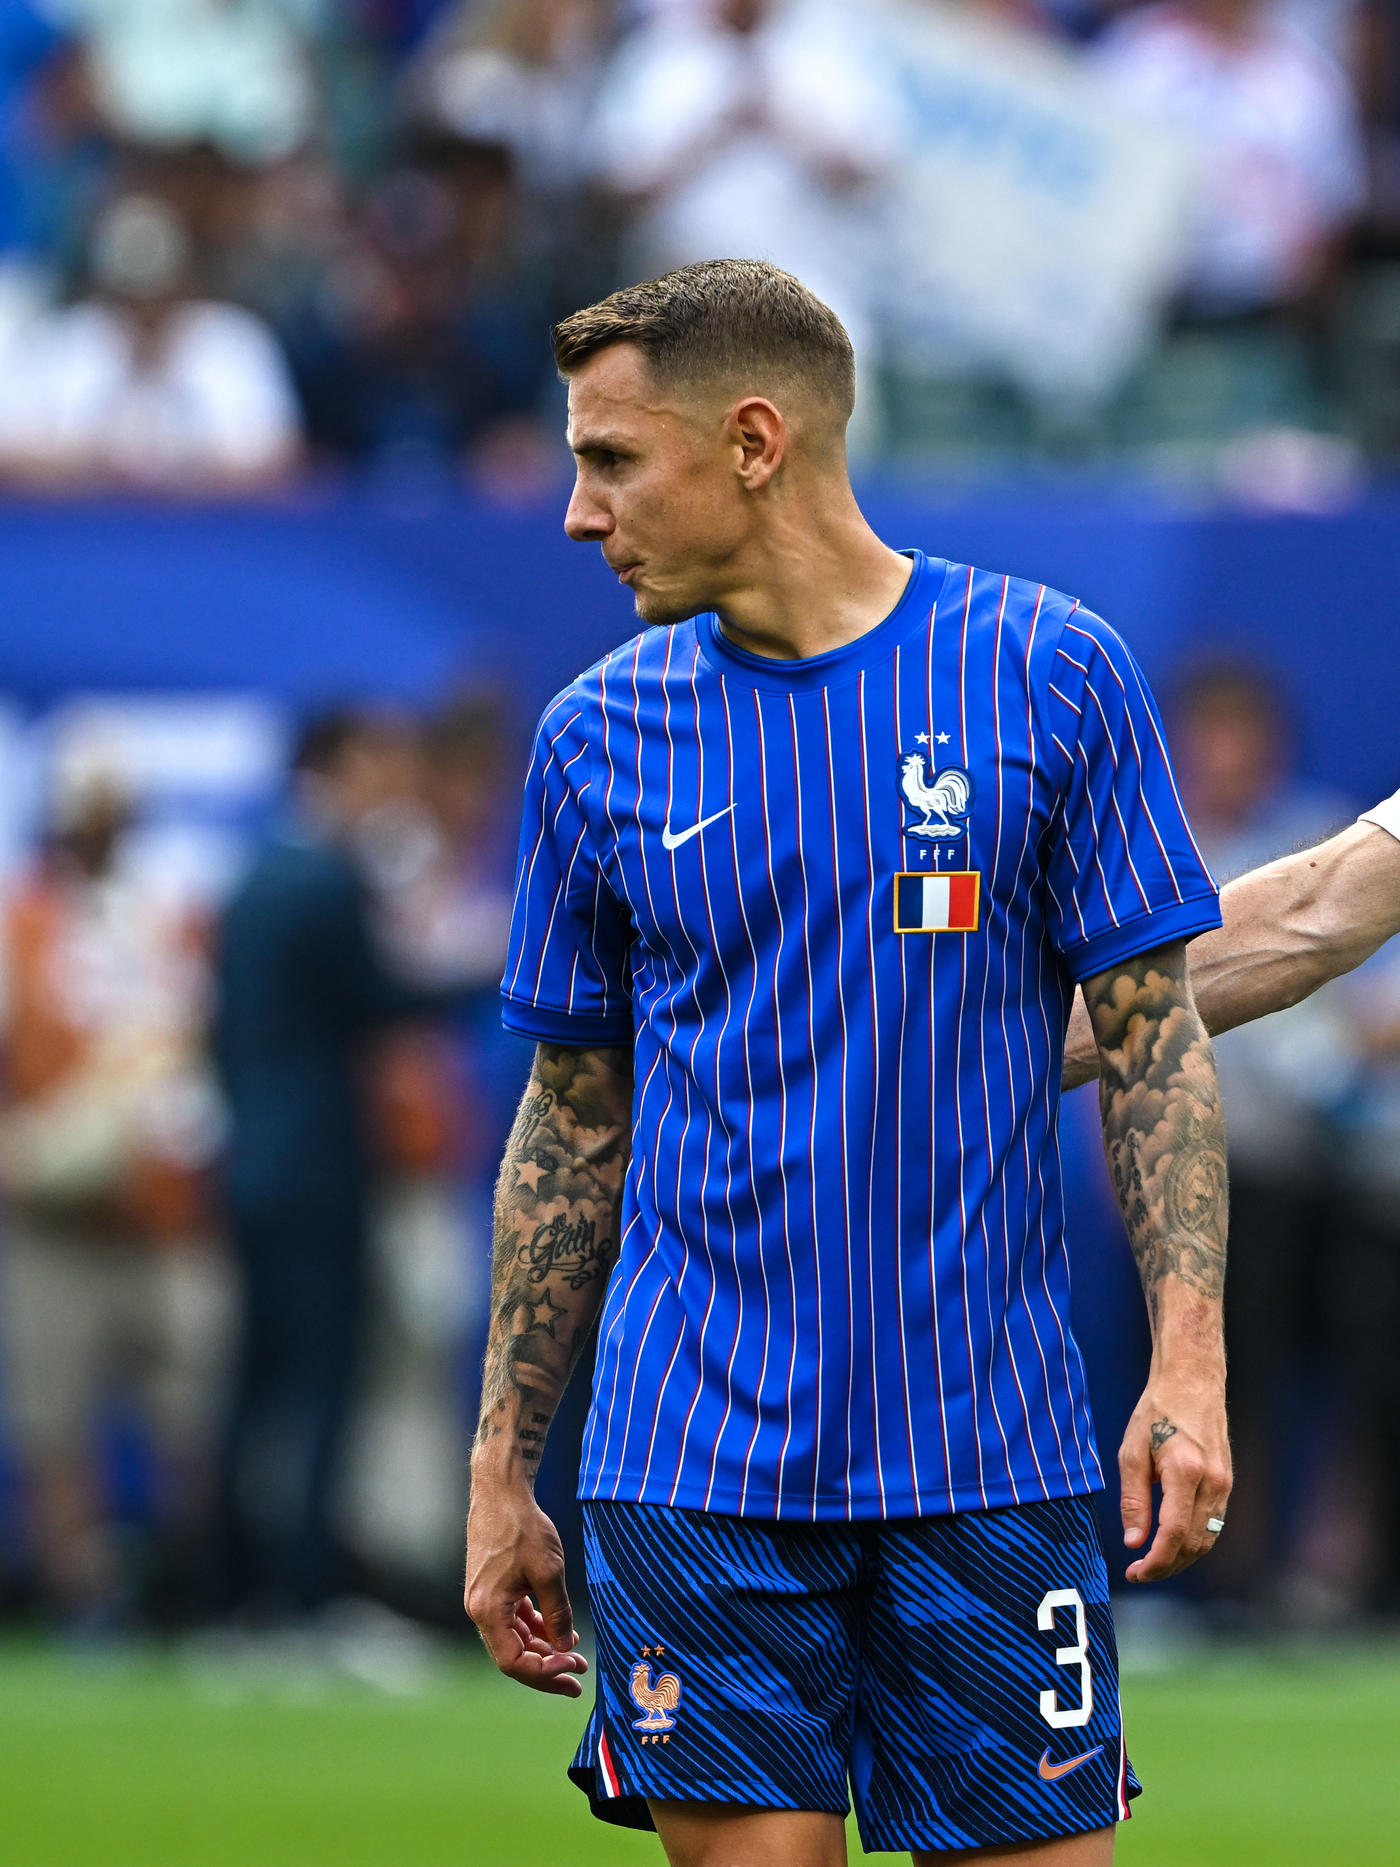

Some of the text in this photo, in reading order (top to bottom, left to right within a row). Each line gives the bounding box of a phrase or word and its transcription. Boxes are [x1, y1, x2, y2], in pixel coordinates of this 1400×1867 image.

[919, 849, 956, 860] FFF
[1036, 1587, 1094, 1729] 3
[641, 1734, 671, 1745] FFF
